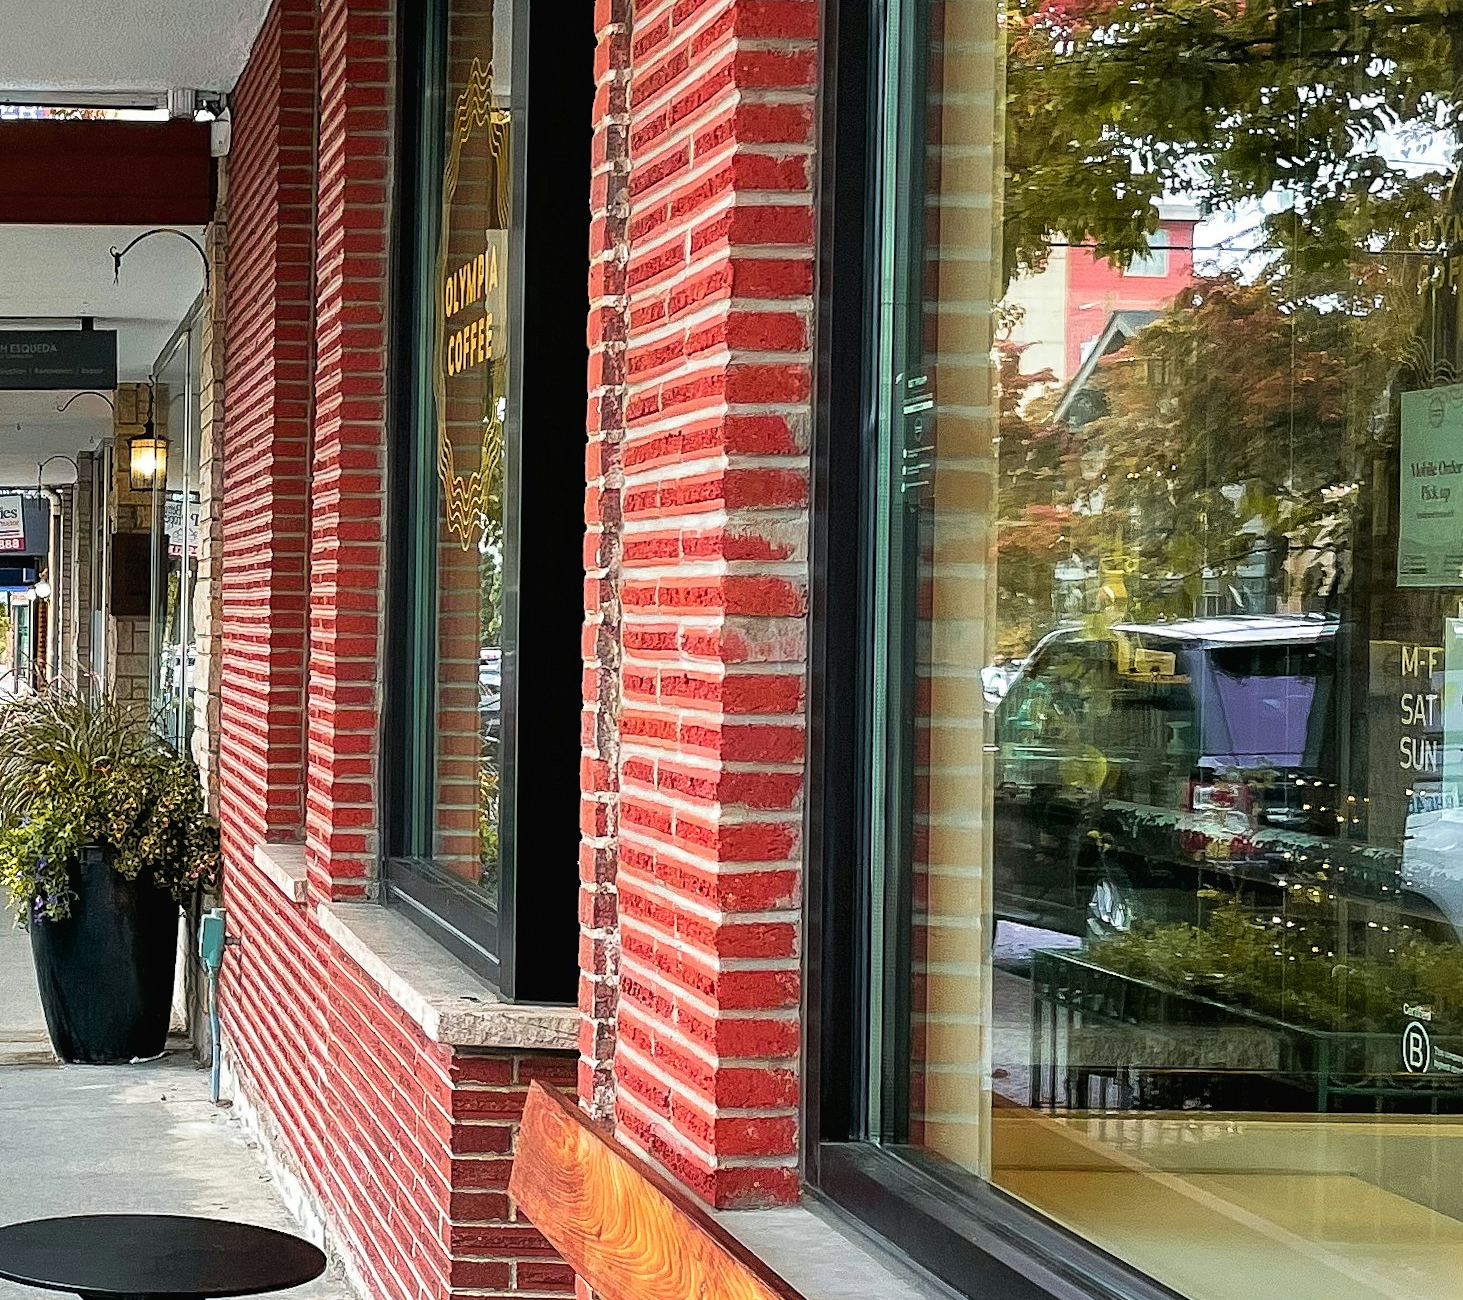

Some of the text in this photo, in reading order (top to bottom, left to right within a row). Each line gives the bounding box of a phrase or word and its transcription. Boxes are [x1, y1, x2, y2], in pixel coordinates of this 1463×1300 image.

[445, 245, 499, 318] OLYMPIA
[447, 312, 494, 377] COFFEE
[1401, 693, 1438, 726] SAT
[1399, 736, 1437, 773] SUN
